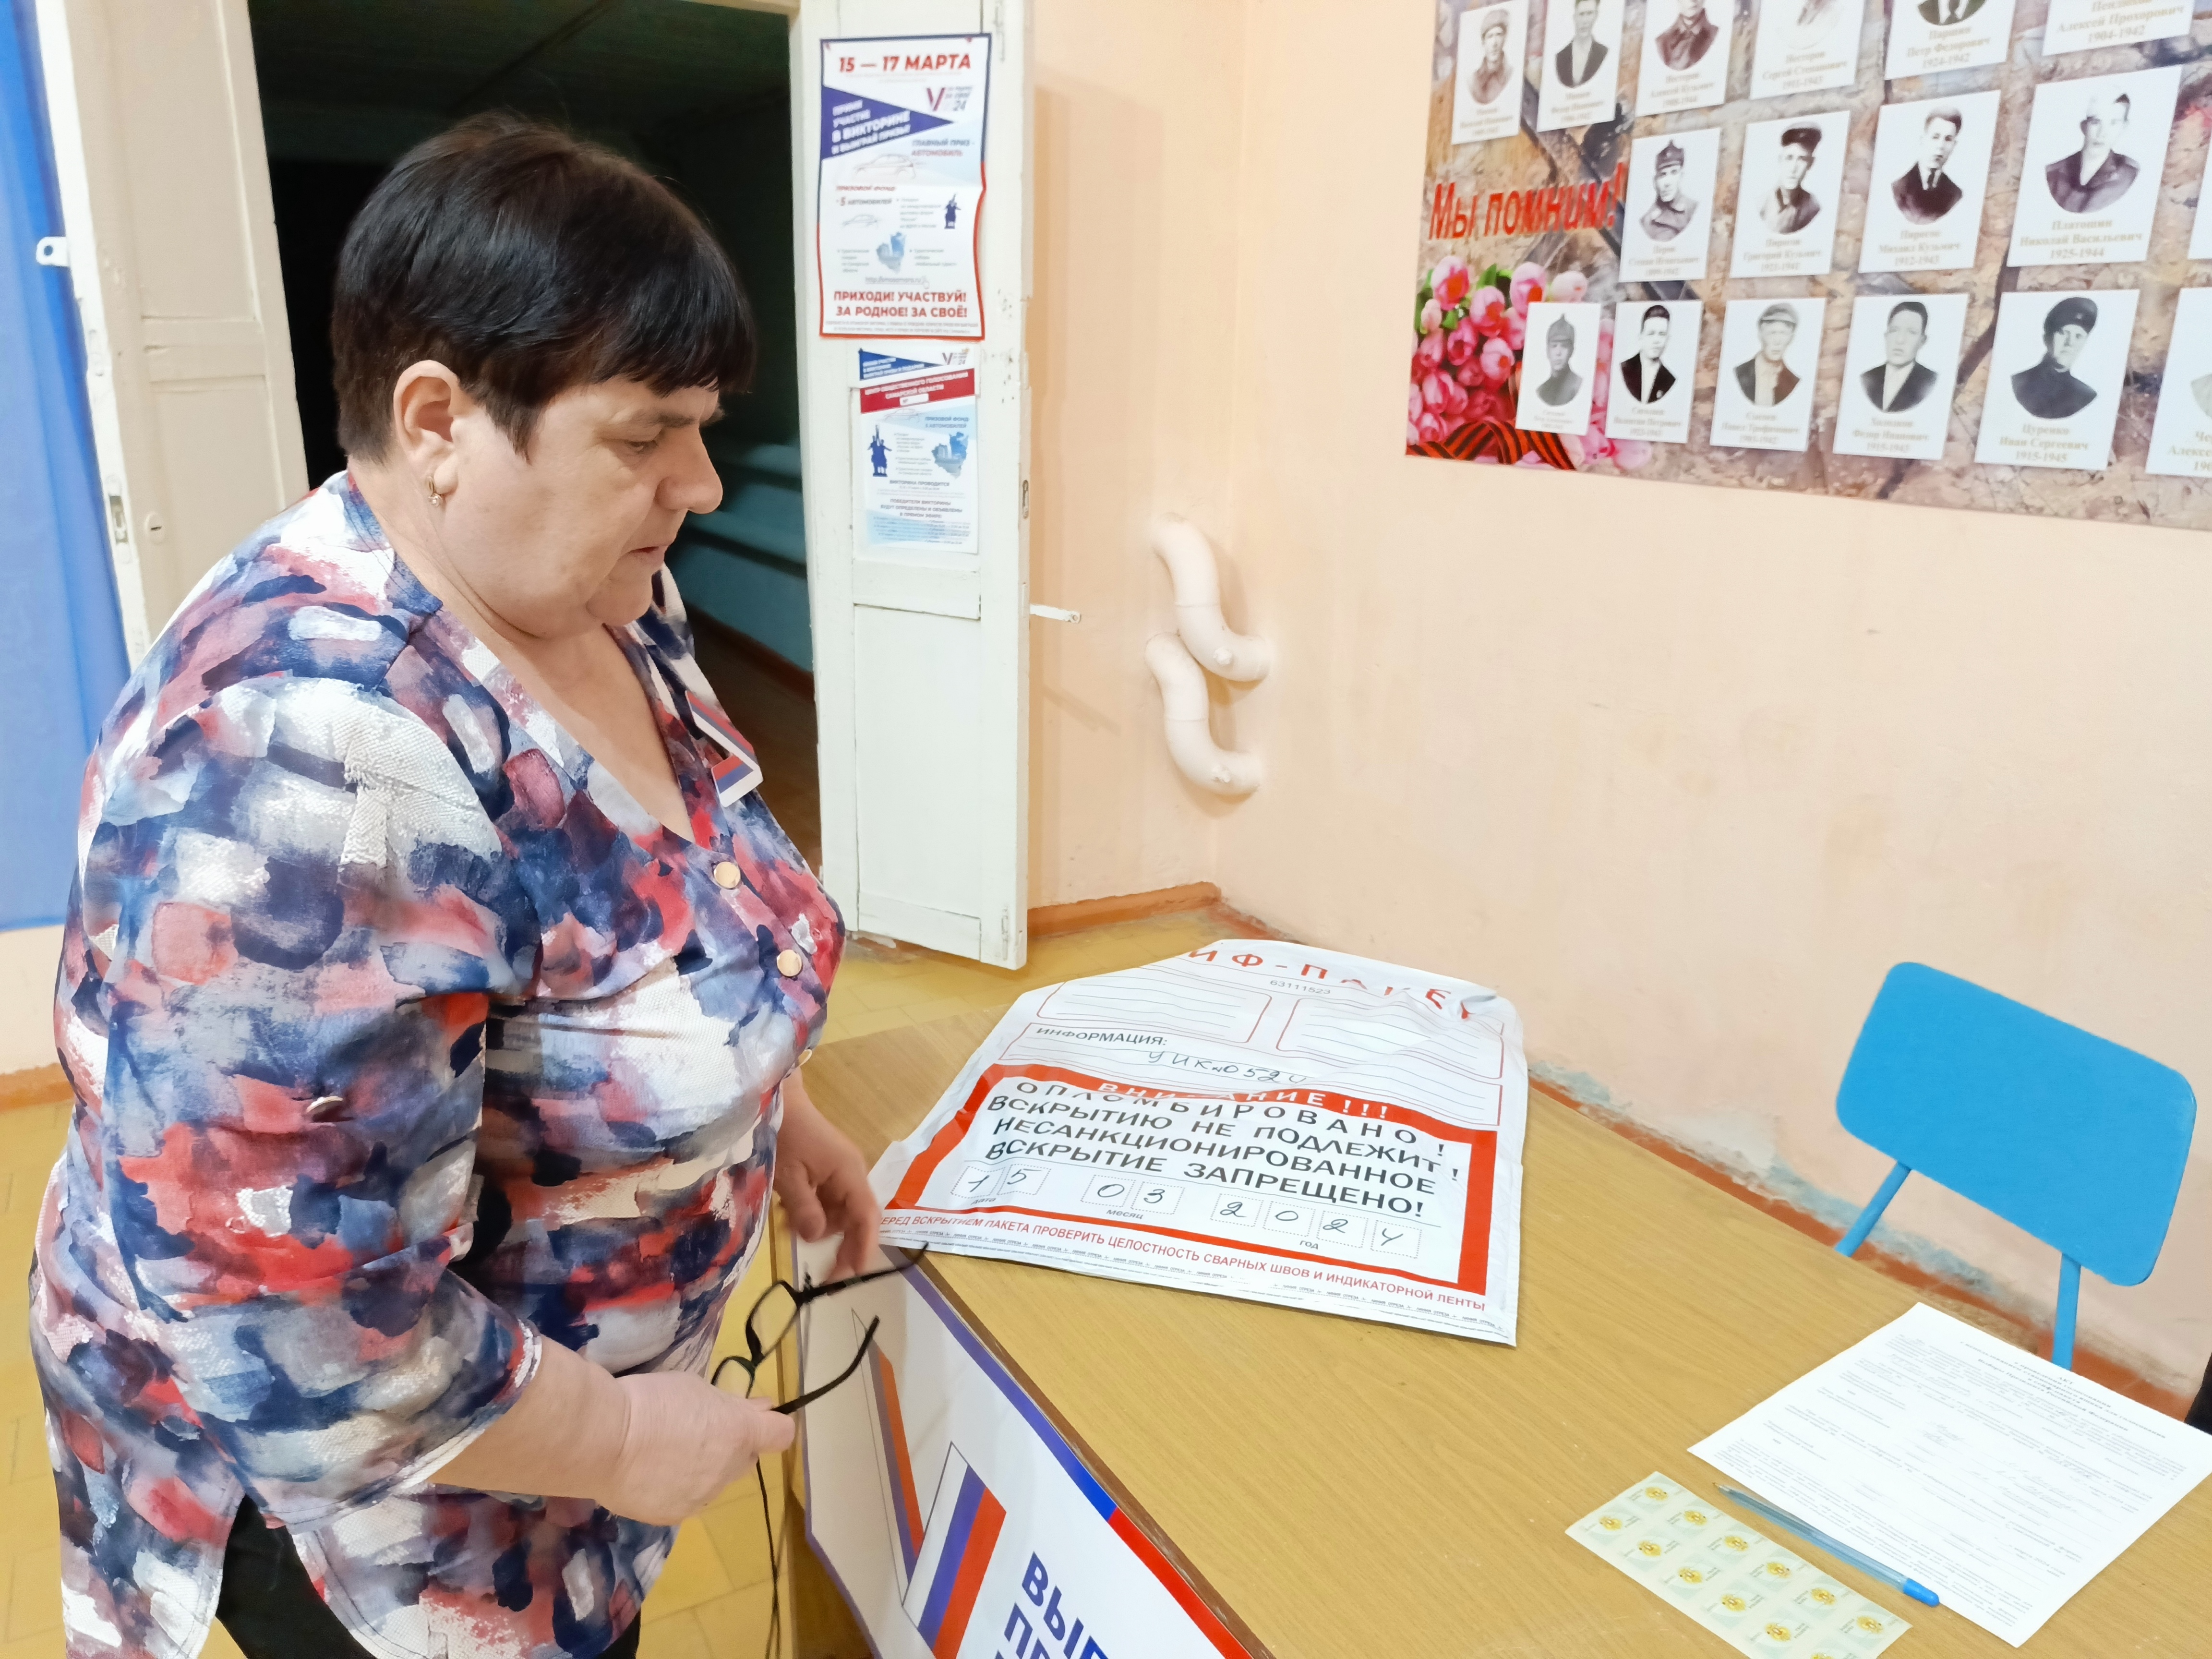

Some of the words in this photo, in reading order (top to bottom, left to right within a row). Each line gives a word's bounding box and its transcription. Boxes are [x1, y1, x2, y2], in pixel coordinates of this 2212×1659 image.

[840, 57, 854, 72] 15
[883, 56, 900, 72] 17
[904, 54, 971, 71] МАРТА
[1428, 182, 1479, 240] Мы
[1483, 162, 1629, 236] помним!
[834, 291, 894, 303] ПРИХОДИ!
[897, 289, 966, 303] УЧАСТВУЙ!
[836, 306, 851, 316] ЗА
[855, 306, 908, 318] РОДНОЕ!
[911, 307, 926, 317] ЗА
[930, 305, 967, 318] СВОЁ!
[1270, 980, 1331, 995] 63111523
[1036, 1028, 1168, 1046] ИНФОРМАЦИЯ:
[987, 1095, 1173, 1130] ВСКРЫТИЮ
[1191, 1120, 1236, 1138] НЕ
[993, 1116, 1437, 1195] НЕСАНКЦИОНИРОВАННОЕ
[985, 1139, 1167, 1172] ВСКРЫТИЕ
[1183, 1162, 1424, 1218] ЗАПРЕЩЕНО!
[971, 1197, 997, 1205] дата
[1106, 1209, 1144, 1220] месяц
[1299, 1240, 1320, 1250] год
[911, 1215, 984, 1226] ВСКРЫТИЕМ
[984, 1219, 1030, 1234] ПАКЕТА
[1032, 1225, 1105, 1244] ПРОВЕРИТЬ
[1107, 1236, 1200, 1261] ЦЕЛОСТНОСТЬ
[1203, 1253, 1267, 1272] СВАРНЫХ
[1270, 1263, 1310, 1278] ШВОВ
[1313, 1271, 1323, 1280] И
[1326, 1272, 1433, 1300] ИНДИКАТОРНОЙ
[1437, 1293, 1485, 1311] ЛЕНТЫ
